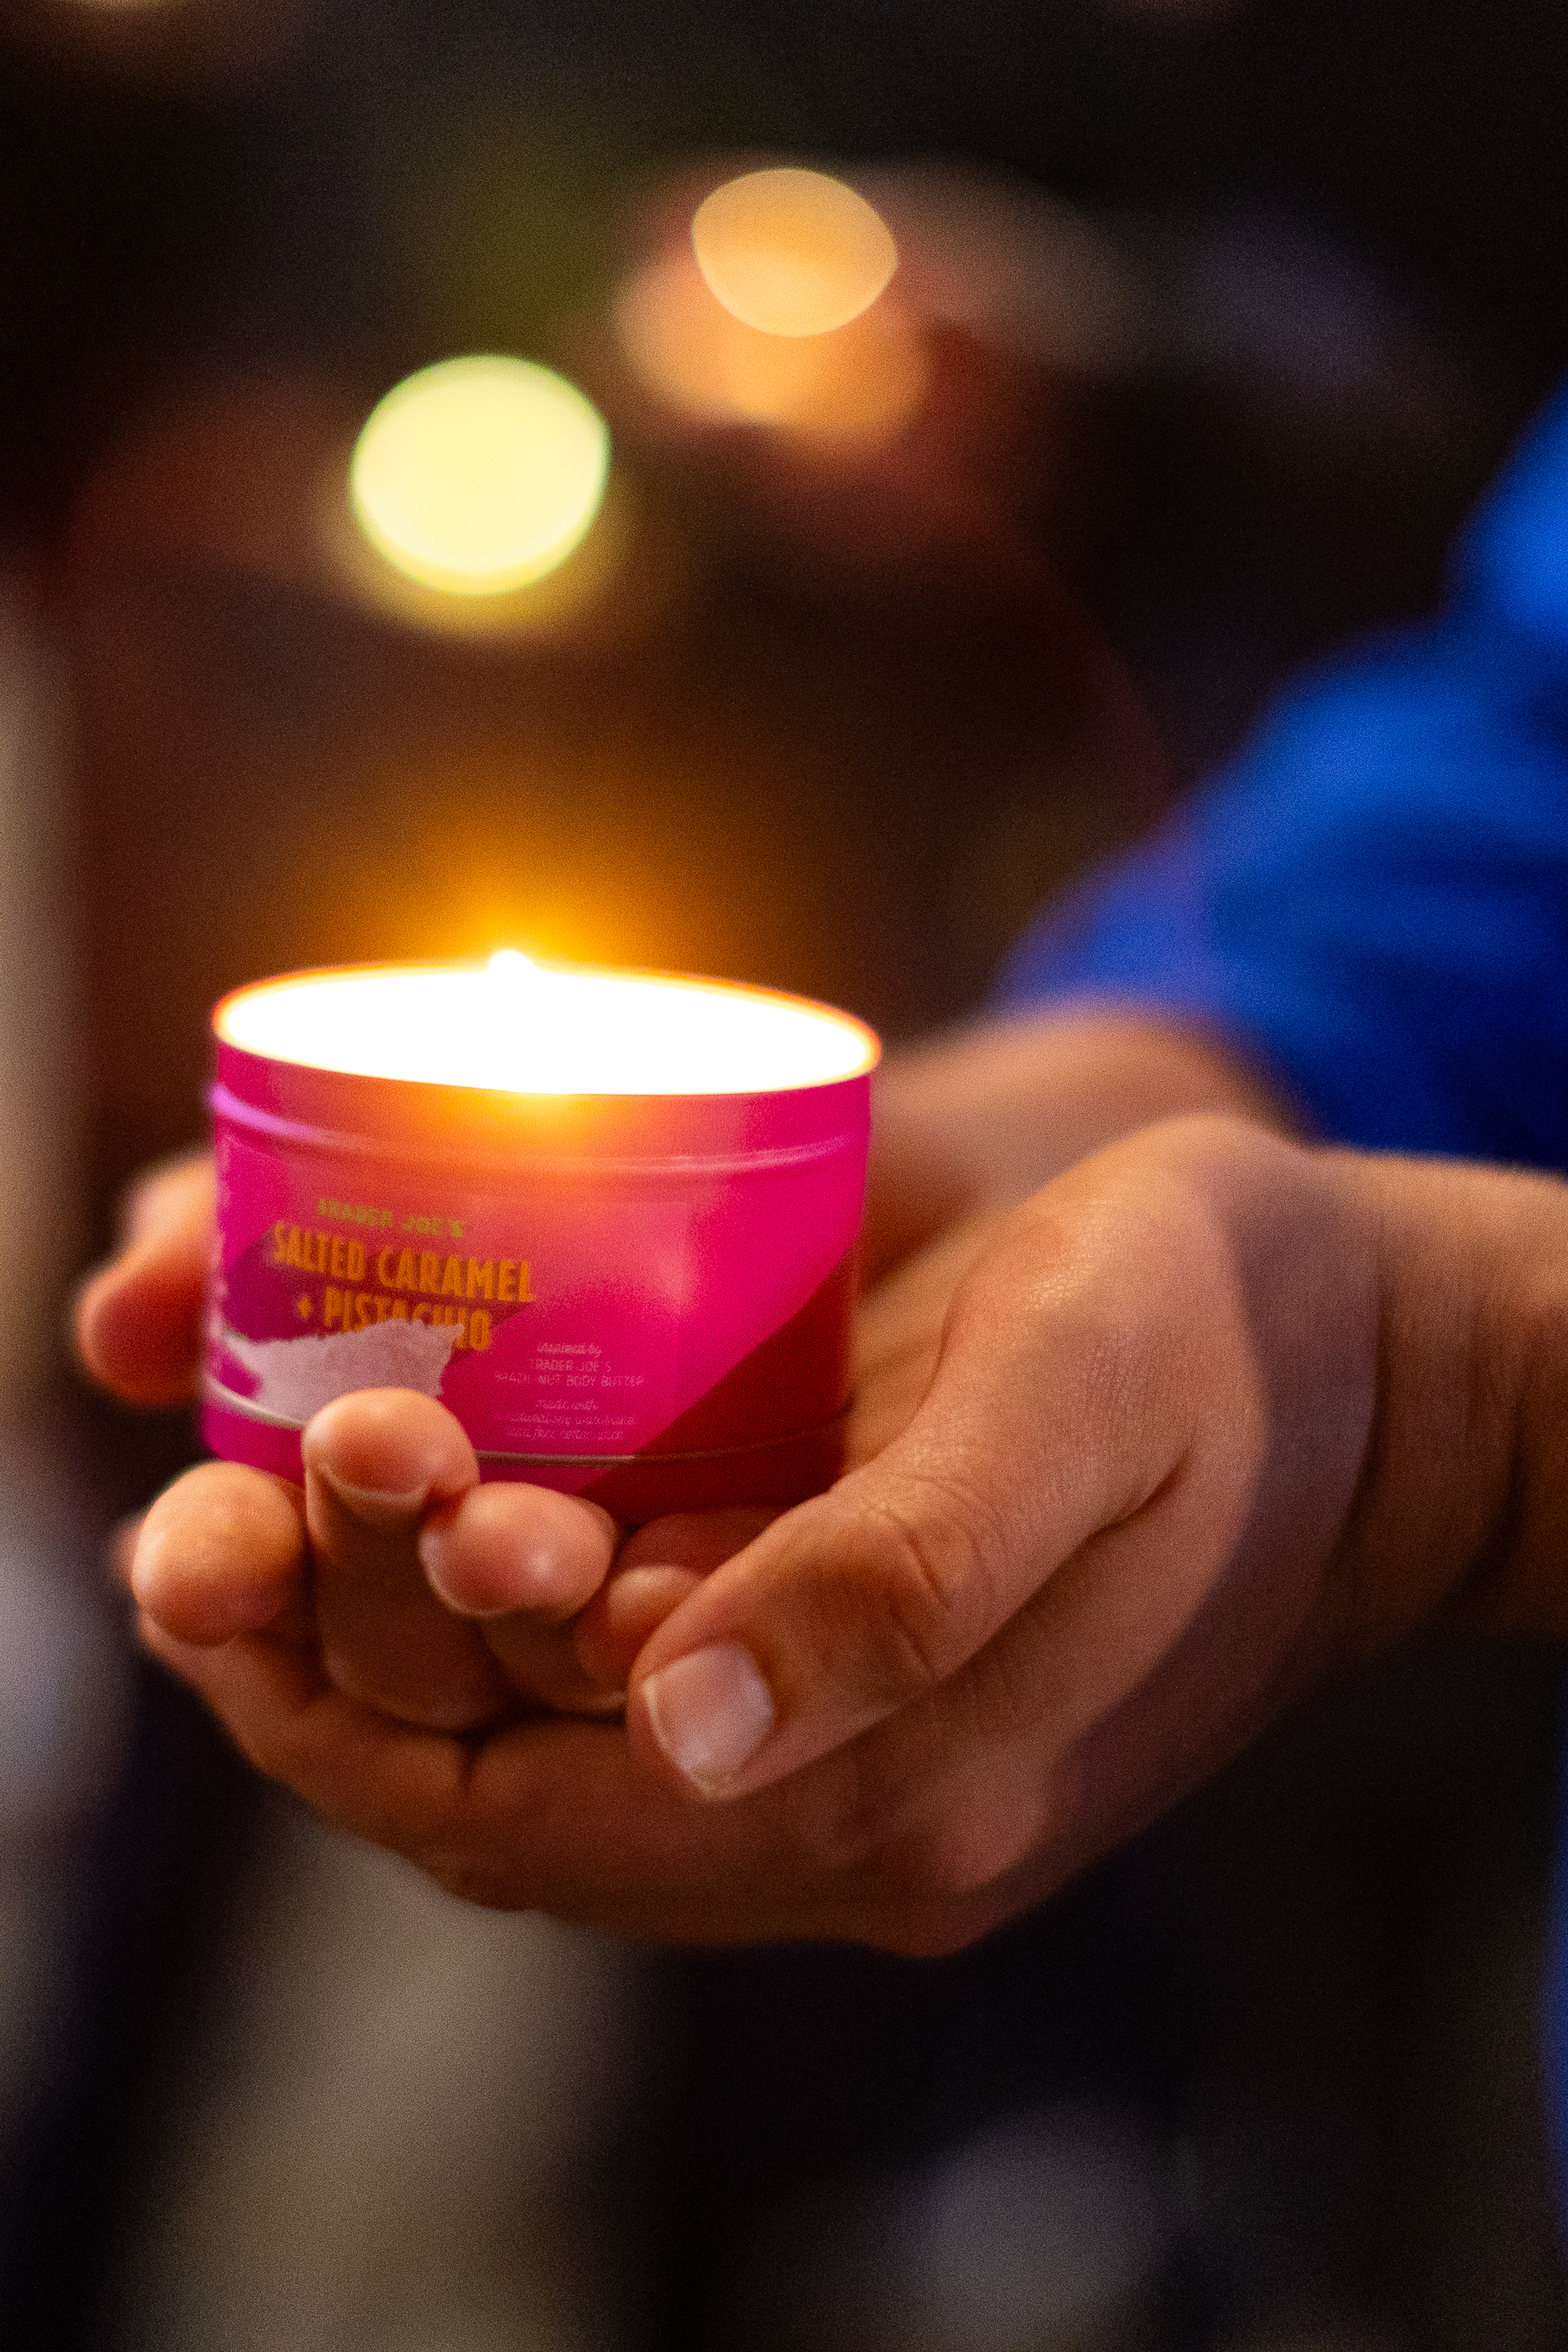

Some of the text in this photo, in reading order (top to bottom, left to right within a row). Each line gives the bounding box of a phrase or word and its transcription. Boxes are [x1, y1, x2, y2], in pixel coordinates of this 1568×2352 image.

[318, 1198, 394, 1228] TRADER
[274, 1221, 537, 1303] SALTED CARAMEL
